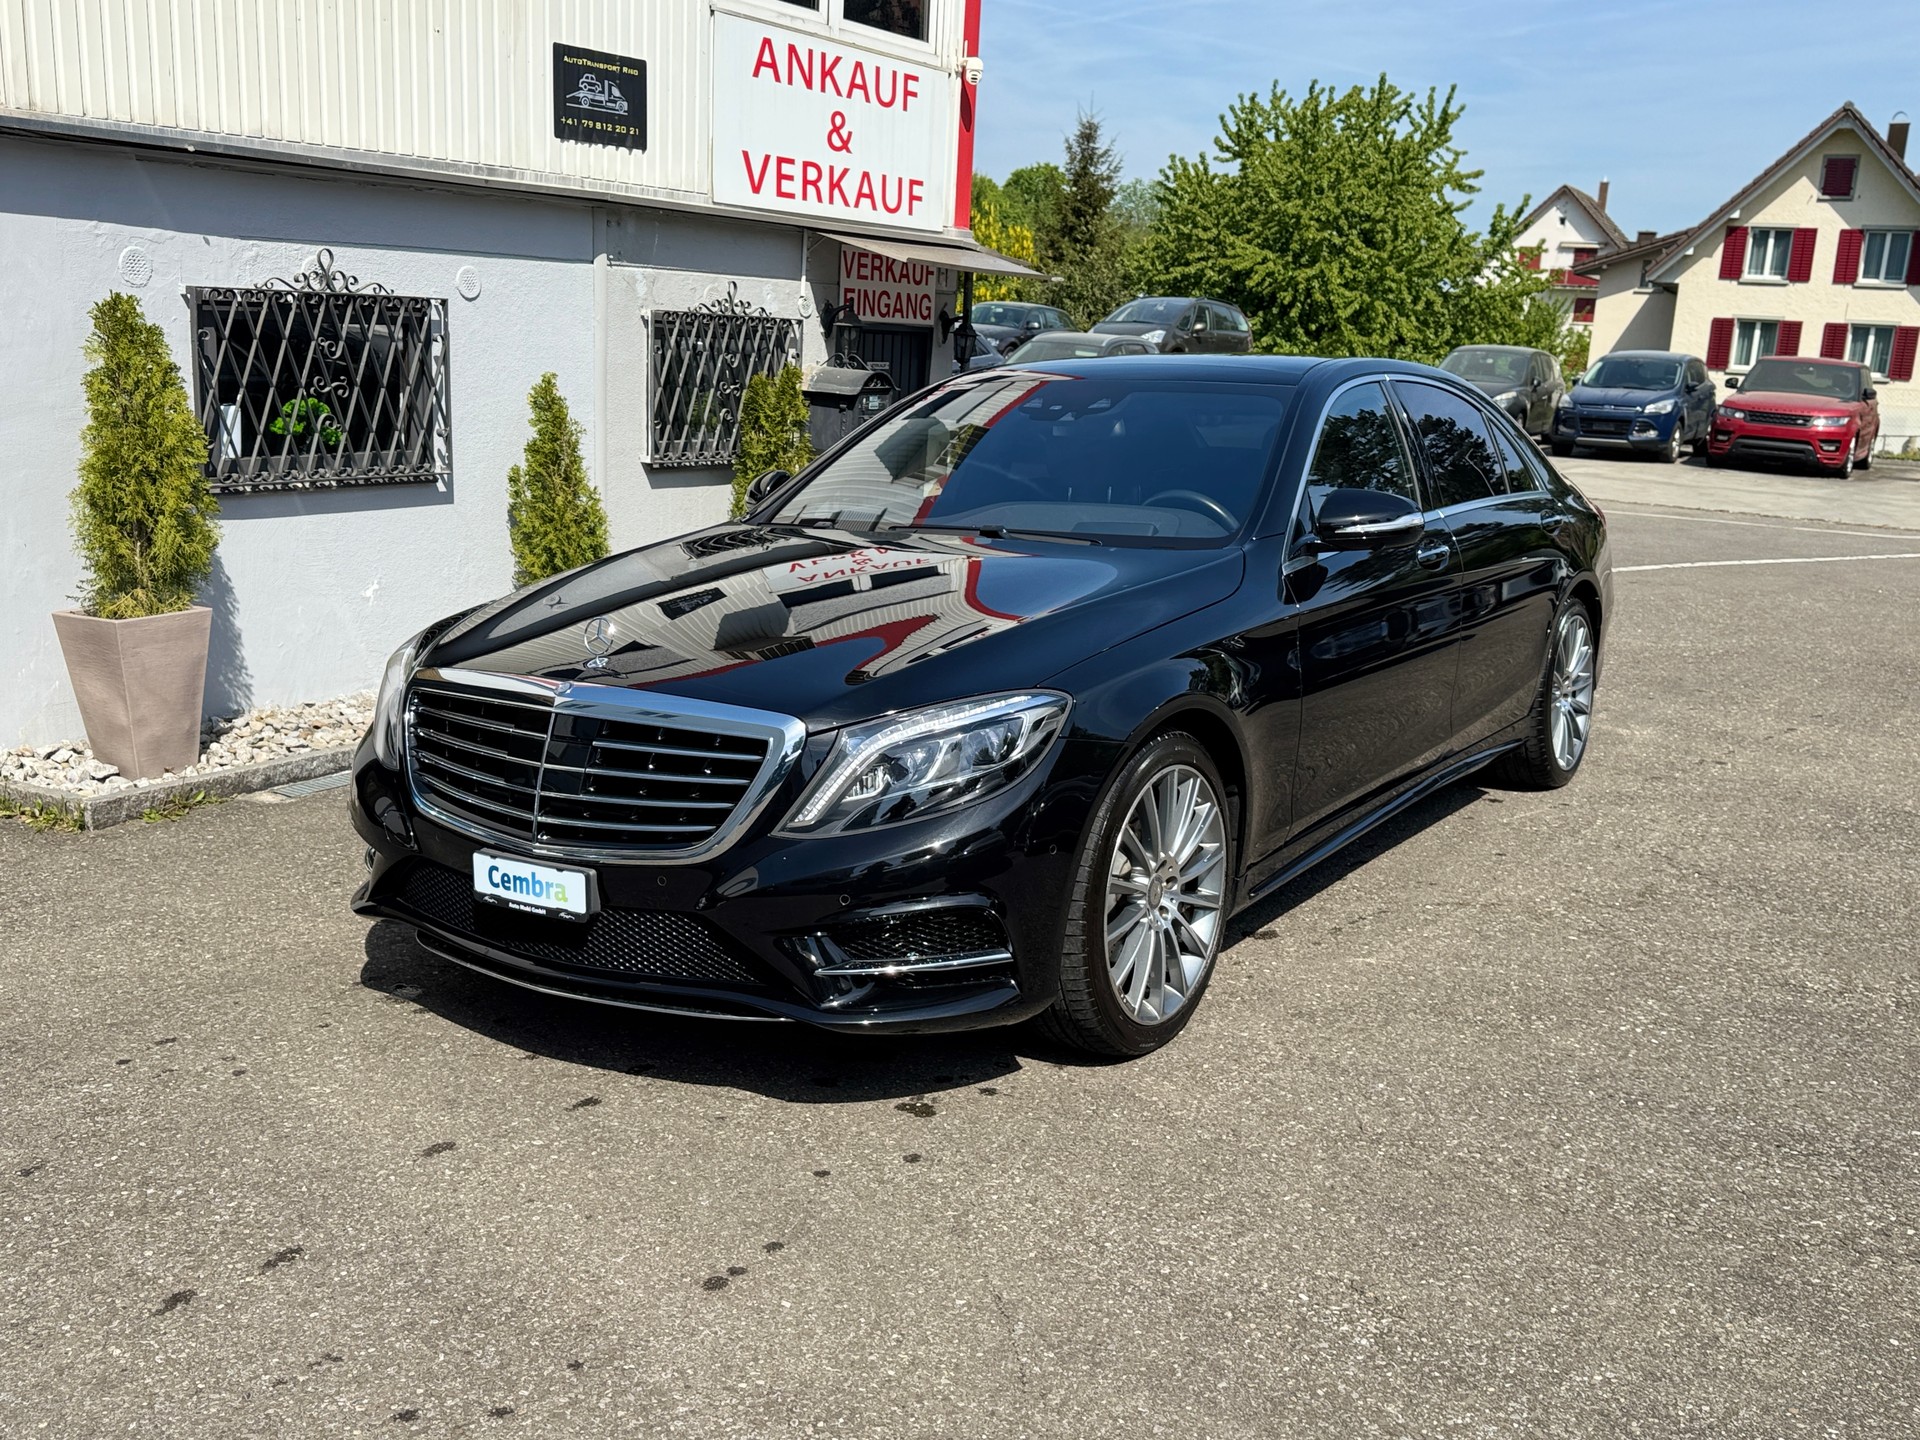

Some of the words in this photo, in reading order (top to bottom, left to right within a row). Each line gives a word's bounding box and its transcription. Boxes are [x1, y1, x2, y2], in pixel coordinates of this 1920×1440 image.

[752, 36, 920, 112] ANKAUF
[560, 116, 578, 126] +41
[582, 119, 594, 128] 79
[595, 122, 613, 132] 812
[615, 125, 627, 133] 20
[629, 127, 639, 135] 21
[827, 110, 853, 154] &
[741, 149, 924, 216] VERKAUF
[842, 250, 935, 286] VERKAUF
[488, 865, 568, 902] Cembra
